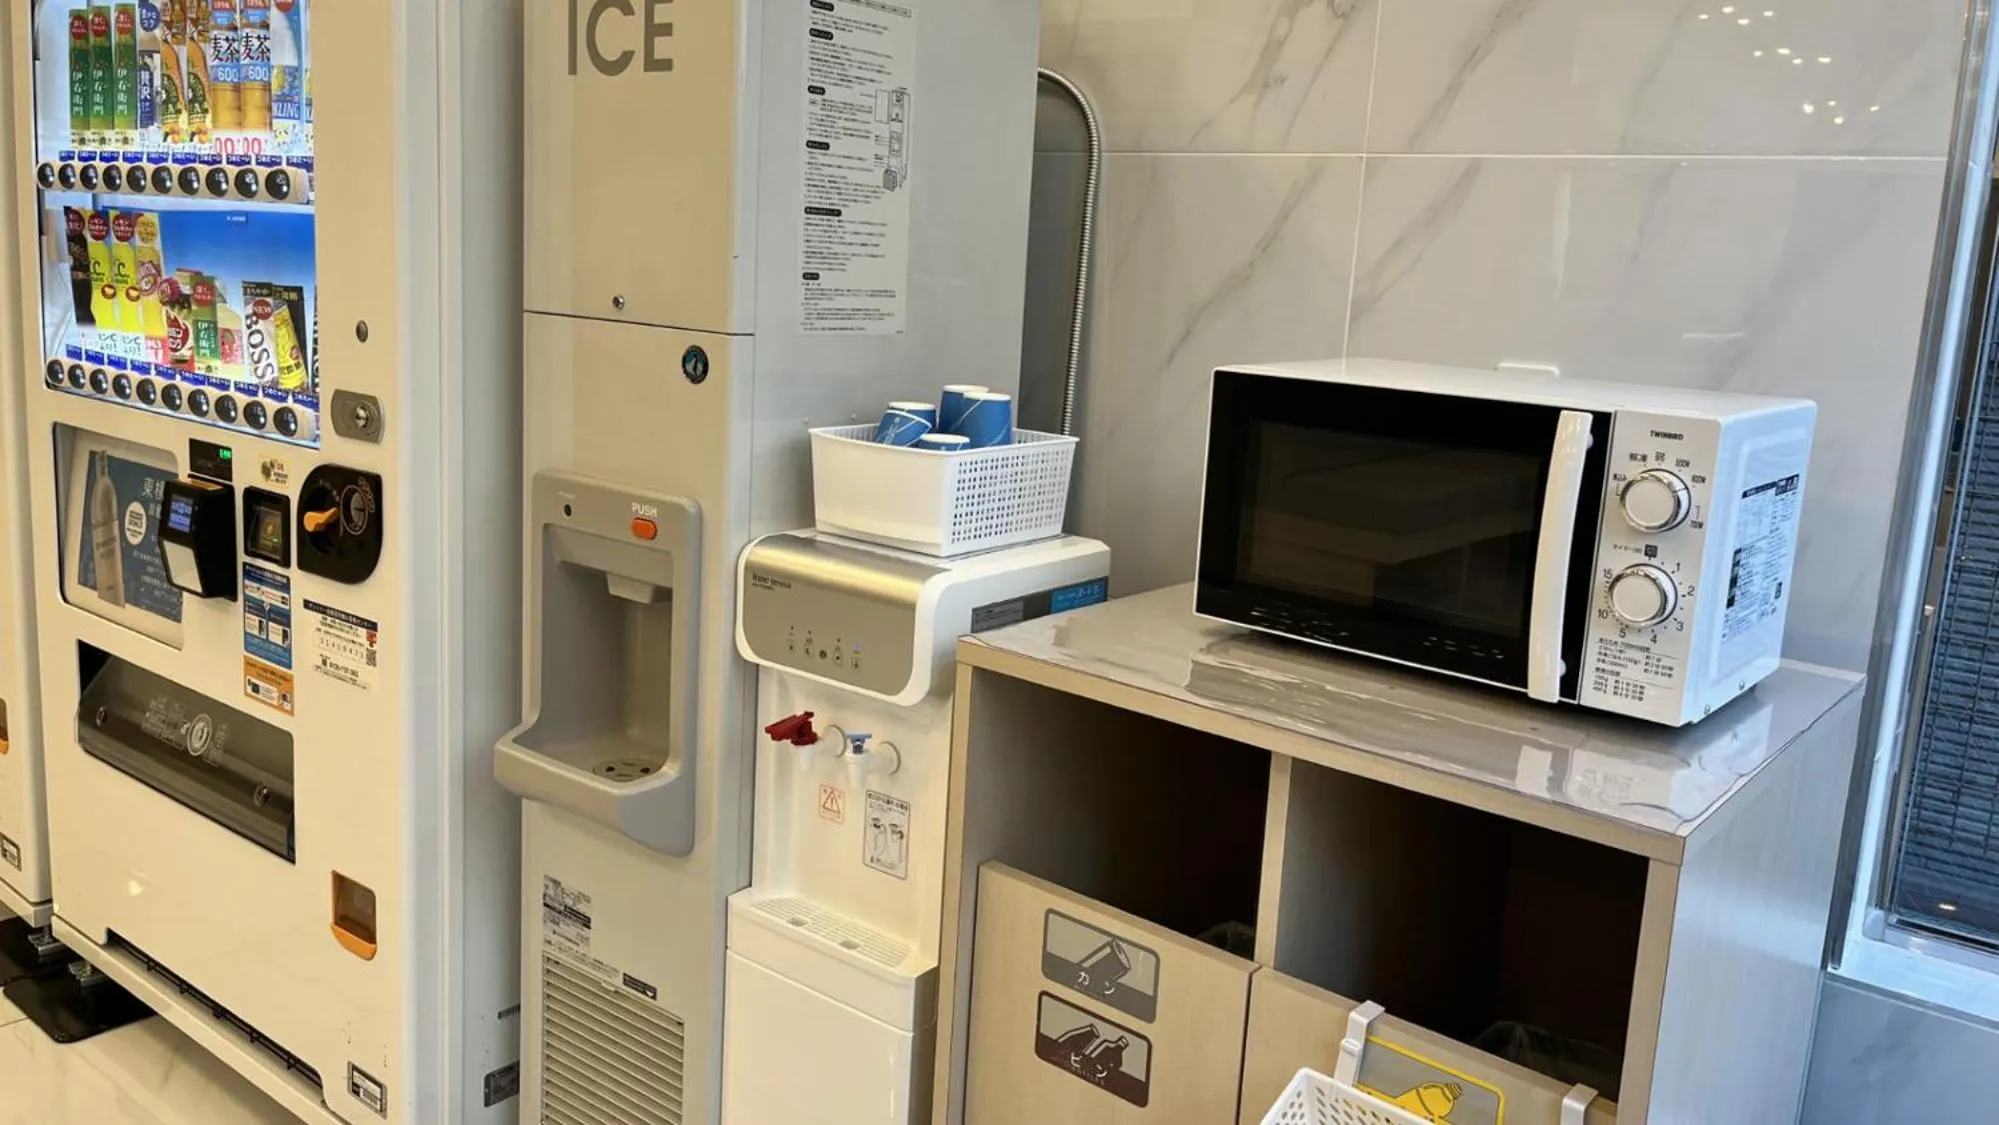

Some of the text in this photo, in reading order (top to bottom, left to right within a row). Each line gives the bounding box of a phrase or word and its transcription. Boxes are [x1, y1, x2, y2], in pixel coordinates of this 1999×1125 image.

[568, 0, 673, 76] ICE
[210, 34, 239, 62] 麦茶
[242, 32, 270, 61] 麦茶
[249, 66, 269, 80] 600
[245, 314, 274, 380] BOSS
[1650, 430, 1684, 440] TWINBIRD
[631, 502, 657, 518] PUSH
[1603, 568, 1613, 579] 15
[1676, 562, 1681, 572] 1
[1687, 585, 1695, 597] 2
[1598, 608, 1609, 620] 10
[1619, 627, 1627, 639] 5
[1676, 621, 1684, 632] 3
[1650, 634, 1658, 644] 4
[1076, 971, 1116, 995] カン
[1070, 1051, 1108, 1079] ビン
